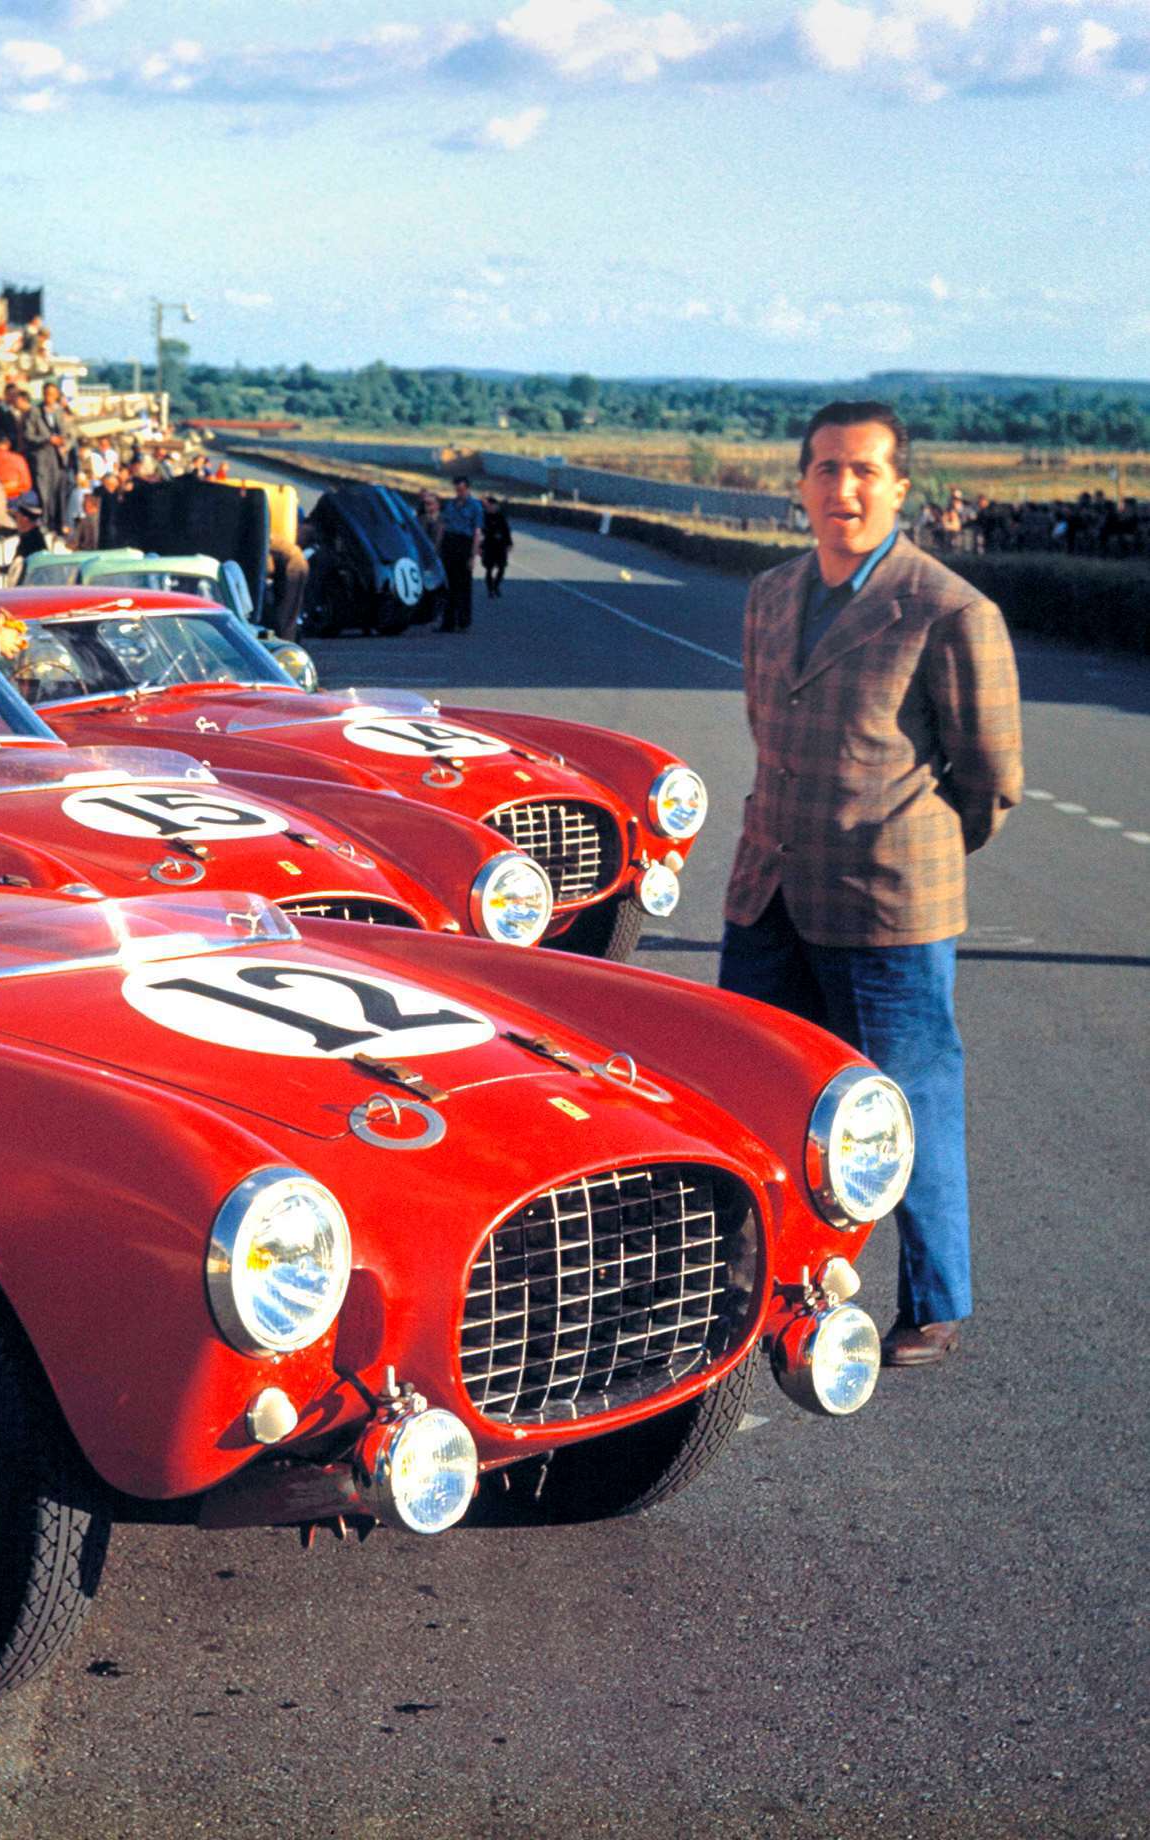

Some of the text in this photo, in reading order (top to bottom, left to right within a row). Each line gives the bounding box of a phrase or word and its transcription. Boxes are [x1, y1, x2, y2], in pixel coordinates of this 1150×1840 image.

[354, 722, 498, 752] 14
[78, 793, 267, 836] 15
[146, 965, 488, 1052] 12
